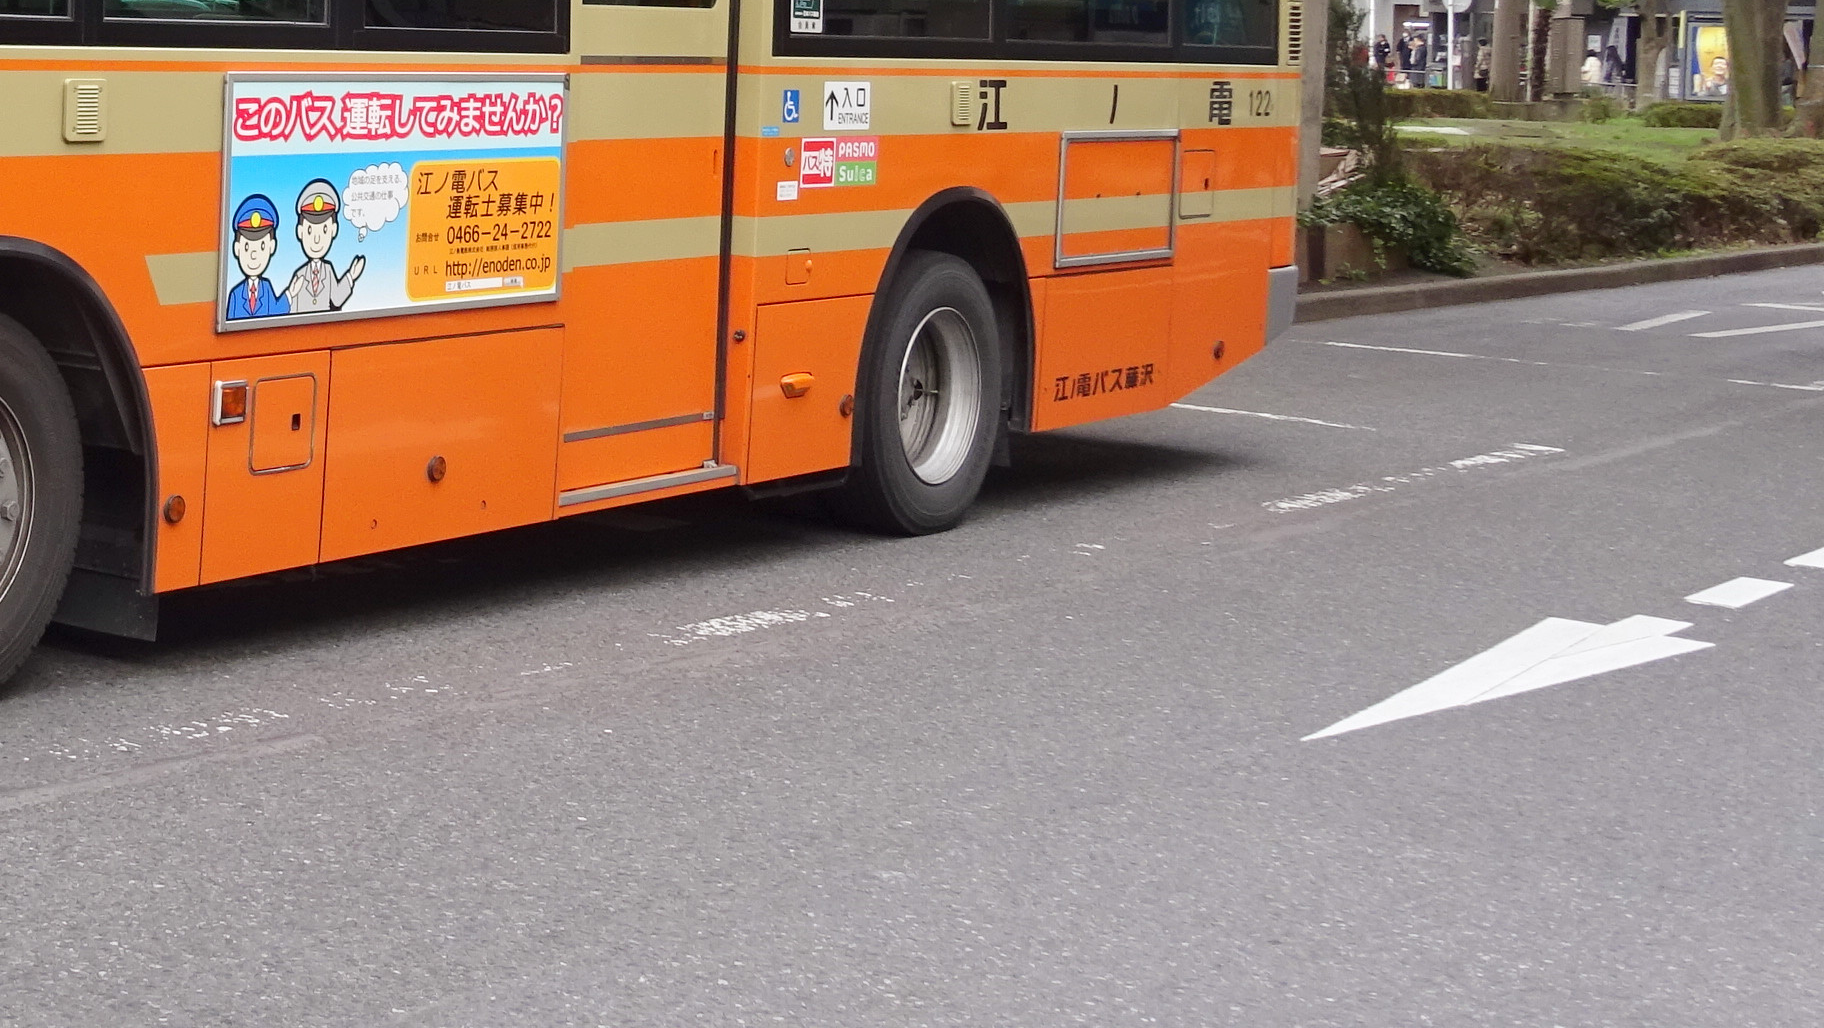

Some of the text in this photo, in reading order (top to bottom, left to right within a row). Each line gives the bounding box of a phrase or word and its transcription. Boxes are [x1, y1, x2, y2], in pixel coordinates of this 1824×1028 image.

[841, 87, 866, 108] 入口
[1249, 89, 1271, 116] 122
[837, 112, 869, 124] ENTRANCE
[838, 141, 875, 158] PASMO
[416, 168, 499, 195] 江ノ電バス
[839, 165, 873, 182] Suica
[415, 232, 440, 243] お問合せ
[445, 254, 551, 278] http://enoden.co.jp
[1053, 363, 1154, 402] 江ノ電バス藤沢
